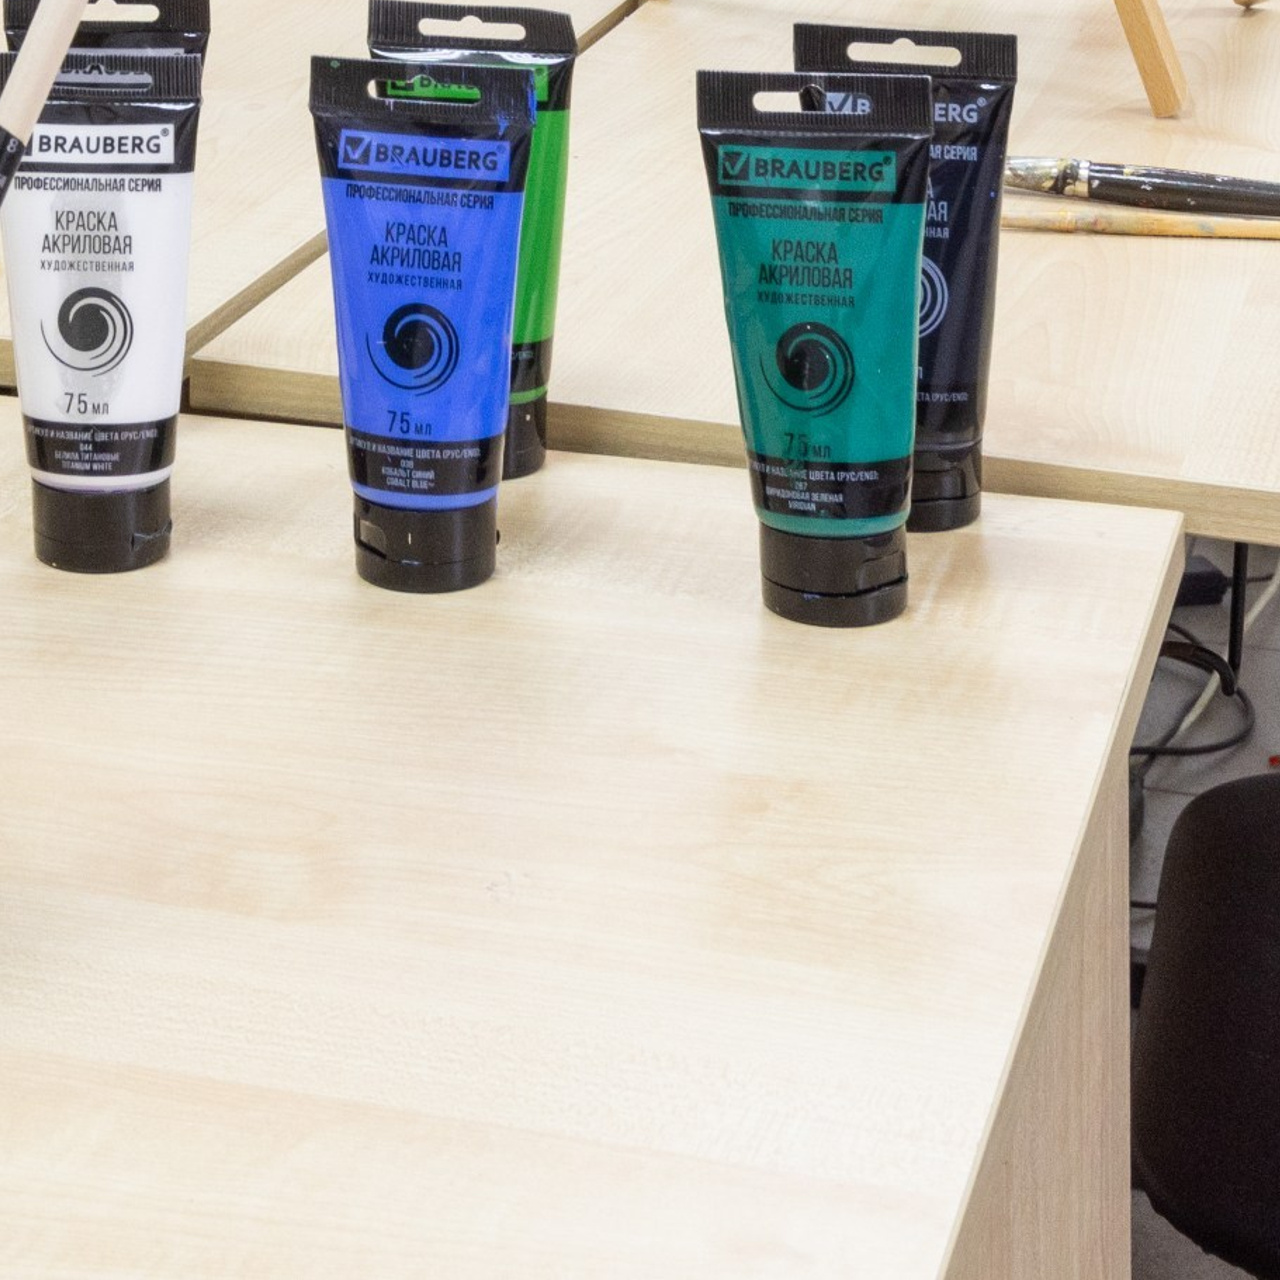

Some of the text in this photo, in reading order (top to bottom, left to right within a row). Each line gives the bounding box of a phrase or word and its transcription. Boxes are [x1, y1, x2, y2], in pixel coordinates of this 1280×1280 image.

[6, 138, 18, 153] 8
[38, 135, 161, 154] BRAUBERG
[375, 144, 498, 171] BRAUBERG
[753, 157, 885, 182] BRAUBERG
[14, 176, 162, 192] ПРОФЕССИОНАЛЬНАЯ СЕРИЯ
[346, 183, 494, 210] ПРОФЕССИОНАЛЬНАЯ СЕРИЯ
[55, 210, 118, 232] КРАСКА
[728, 202, 884, 224] ПРОФЕССИОНАЛЬНАЯ СЕРИЯ
[41, 234, 133, 255] АКРИЛОВАЯ
[385, 221, 448, 248] КРАСКА
[371, 245, 463, 273] АКРИЛОВАЯ
[771, 239, 839, 264] КРАСКА
[40, 259, 135, 273] ХУДОЖЕСТВЕННАЯ
[758, 263, 854, 290] АКРИЛОВАЯ
[367, 271, 463, 291] ХУДОЖЕСТВЕННАЯ
[757, 290, 855, 307] ХУДОЖЕСТВЕННАЯ
[64, 392, 88, 415] 75
[387, 410, 410, 434] 75
[783, 433, 809, 457] 75
[809, 470, 835, 482] ЦВЕТА
